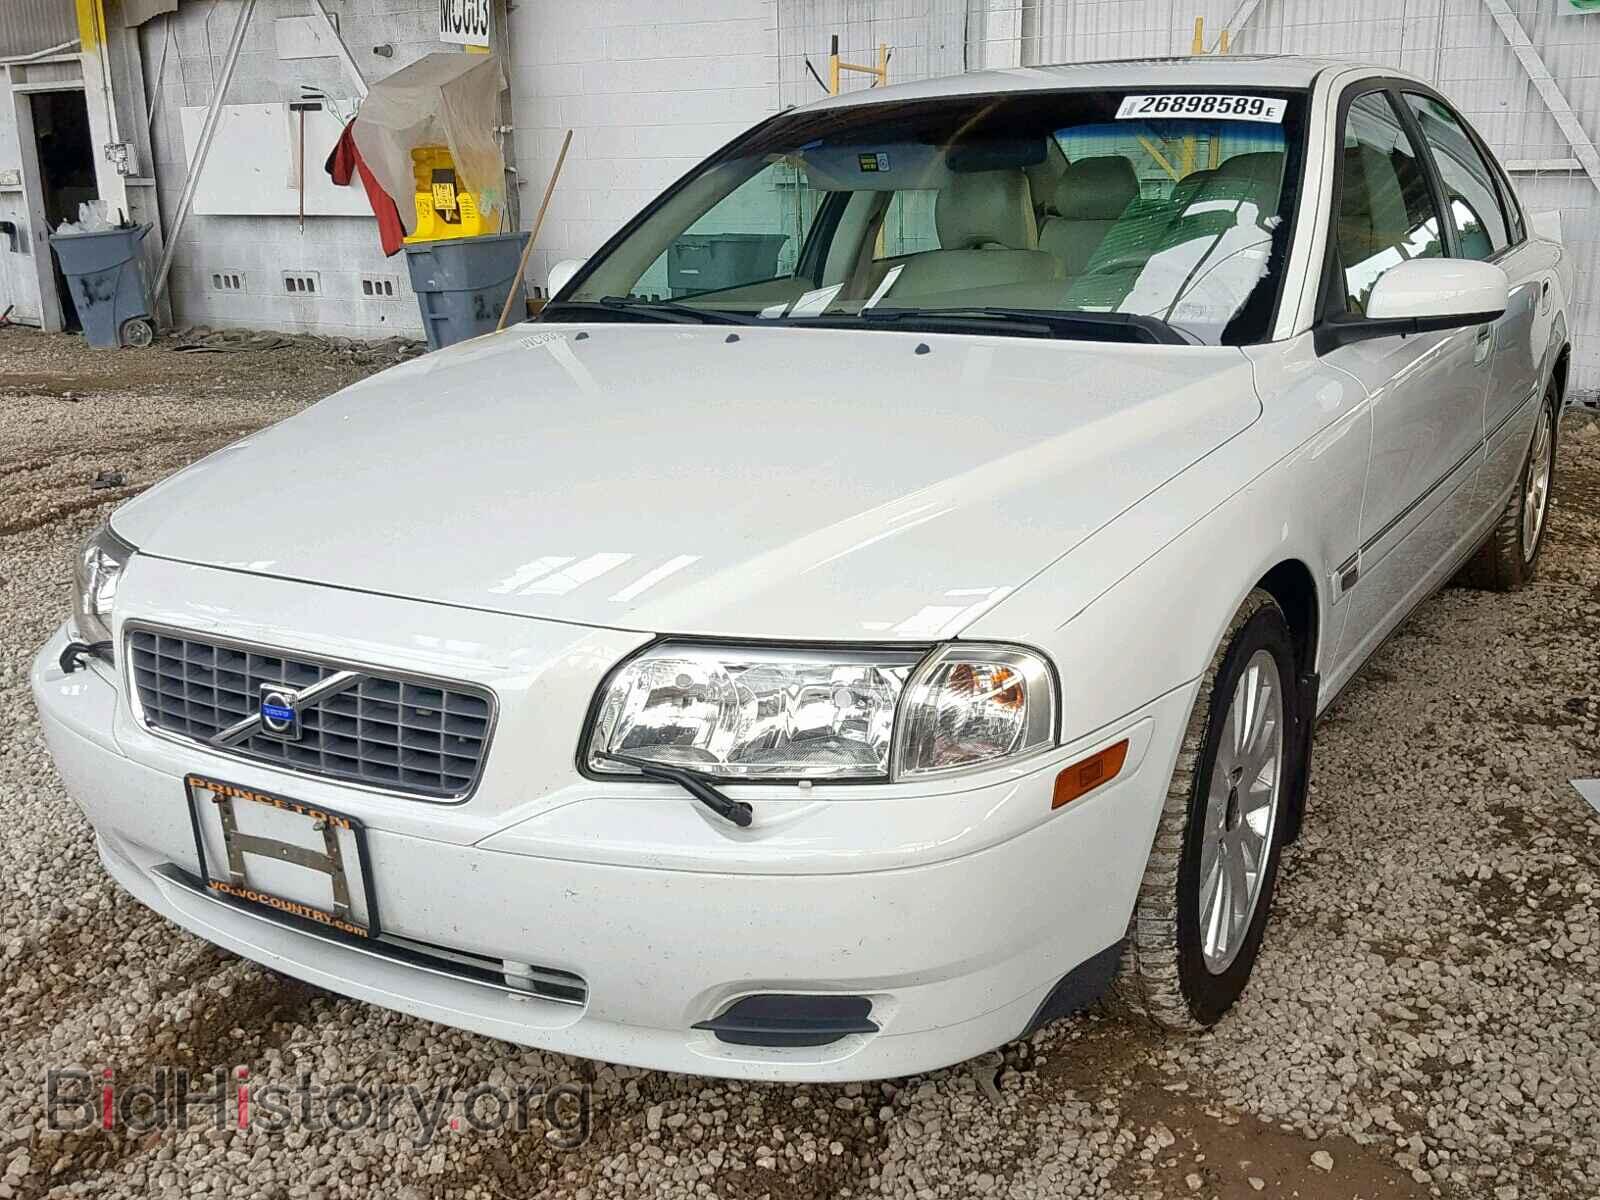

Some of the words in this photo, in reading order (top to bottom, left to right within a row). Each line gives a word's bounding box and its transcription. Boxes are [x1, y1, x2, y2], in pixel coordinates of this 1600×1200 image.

[1138, 96, 1265, 116] 26898589
[189, 777, 350, 829] PRINCETON
[208, 880, 369, 938] VOLVOCOUNTRY.com
